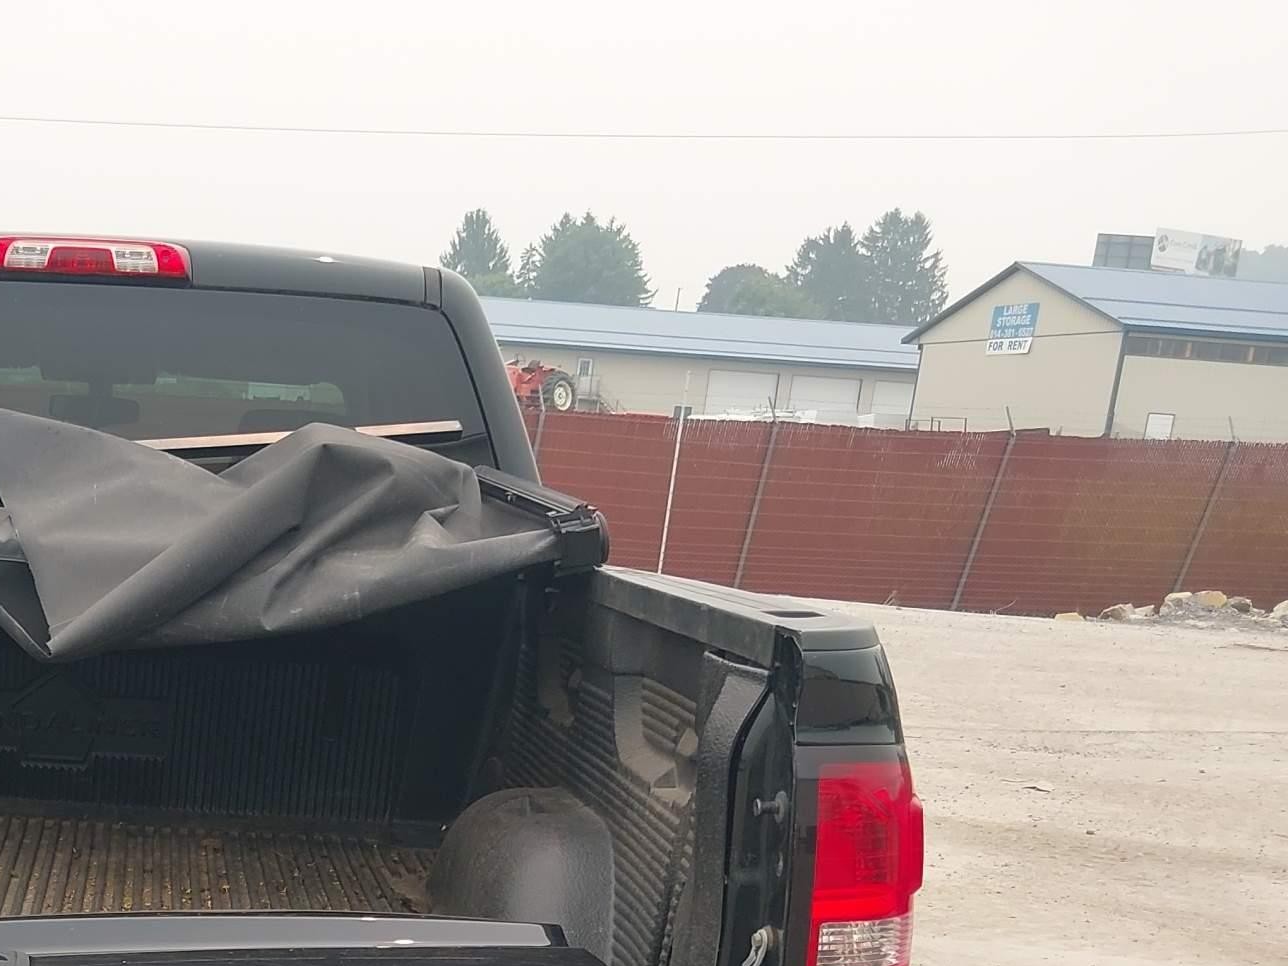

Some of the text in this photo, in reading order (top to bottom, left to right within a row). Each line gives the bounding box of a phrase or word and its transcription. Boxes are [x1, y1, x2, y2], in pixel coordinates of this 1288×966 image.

[1003, 304, 1029, 315] LARGE
[996, 314, 1032, 327] STORAGE
[988, 340, 1029, 352] FOR RENT
